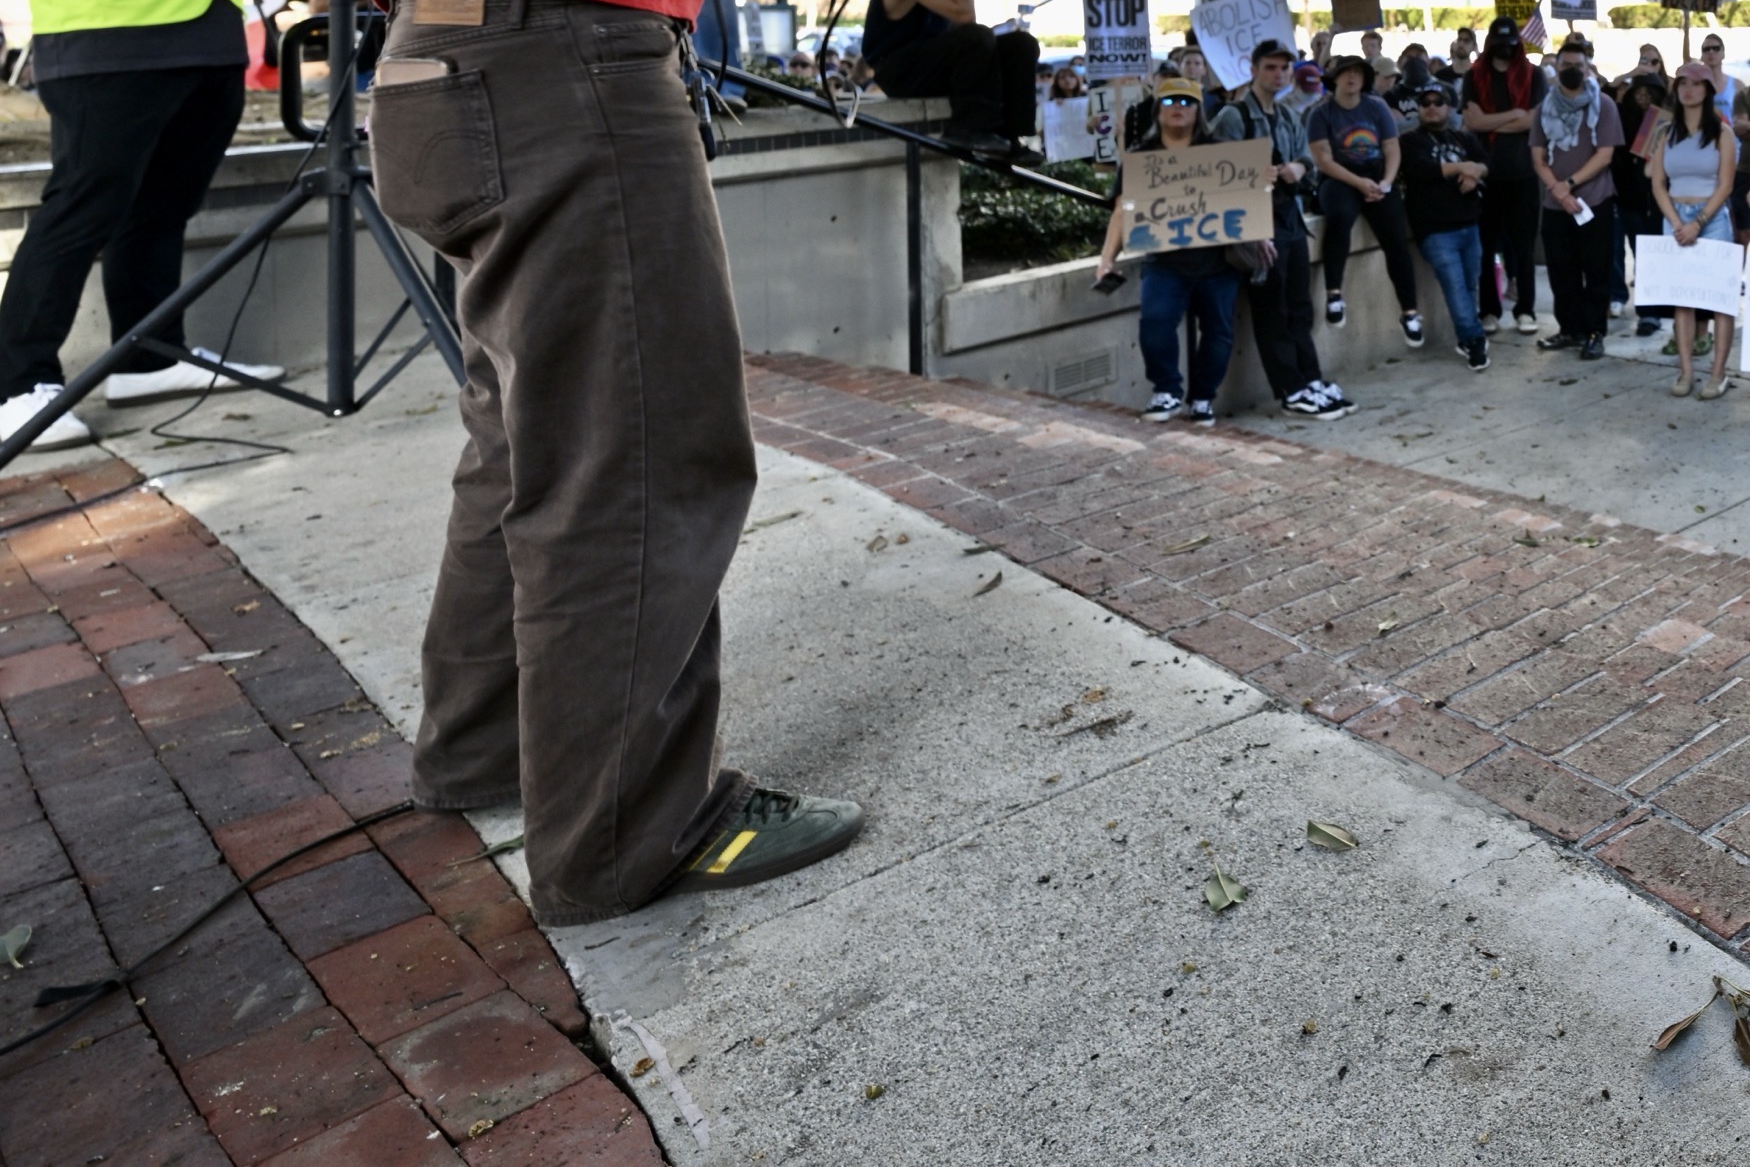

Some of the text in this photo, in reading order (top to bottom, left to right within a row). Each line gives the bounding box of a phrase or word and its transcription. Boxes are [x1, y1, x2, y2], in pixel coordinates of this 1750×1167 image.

[1088, 36, 1147, 51] ICE TERROR
[1225, 24, 1262, 57] ICE
[1089, 53, 1147, 62] NOW!
[1146, 160, 1258, 189] Beautiful Day
[1184, 185, 1196, 196] to
[1151, 192, 1207, 220] Crush
[1168, 210, 1246, 246] ICE
